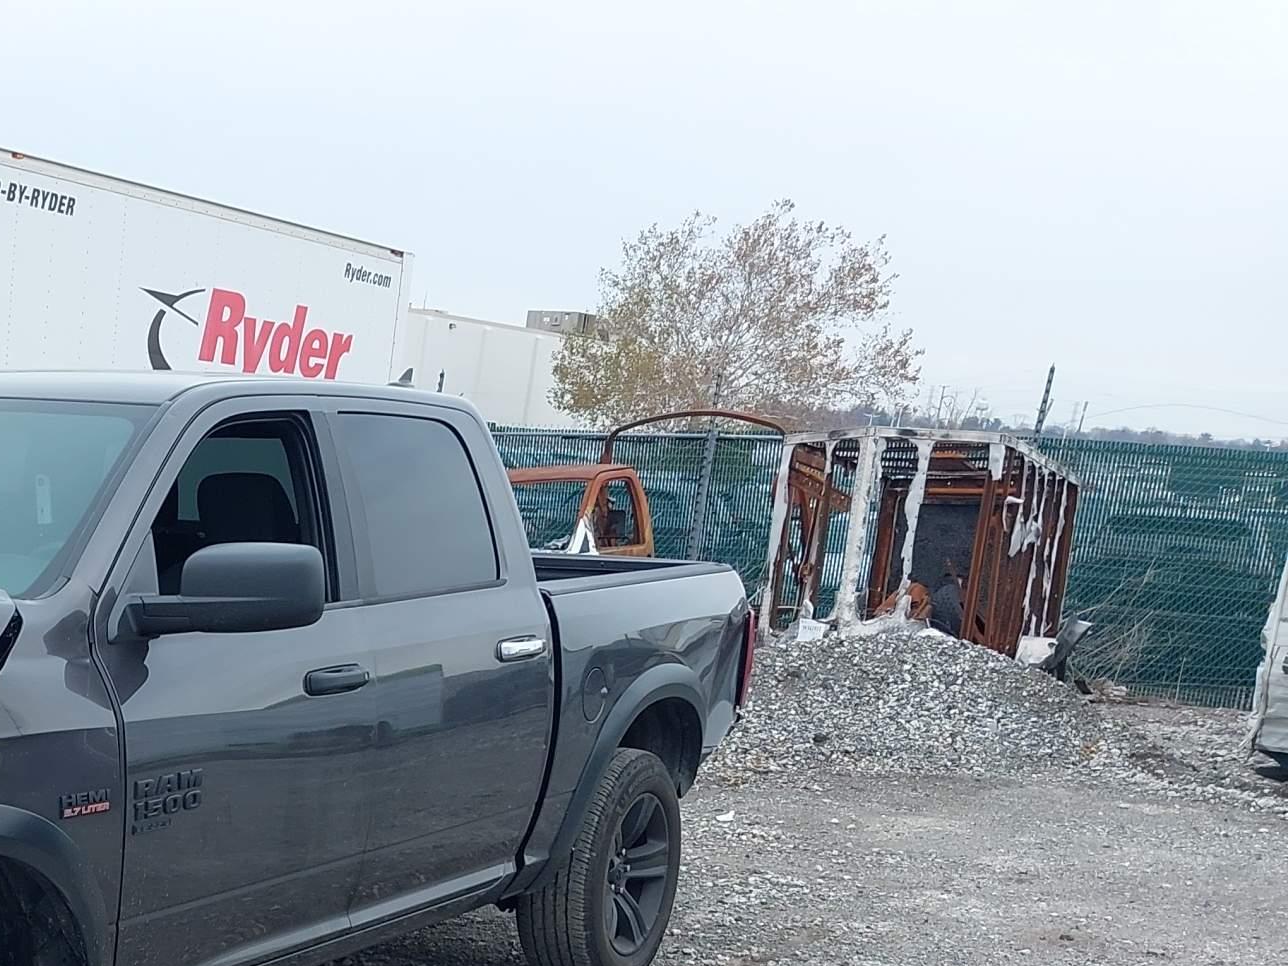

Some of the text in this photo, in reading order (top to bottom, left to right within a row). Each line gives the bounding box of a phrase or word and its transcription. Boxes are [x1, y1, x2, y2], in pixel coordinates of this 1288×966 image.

[344, 262, 392, 289] Ryder.com
[199, 288, 353, 380] Ryder
[60, 788, 111, 808] HEMI
[133, 767, 203, 800] RAM
[133, 789, 202, 822] 1500
